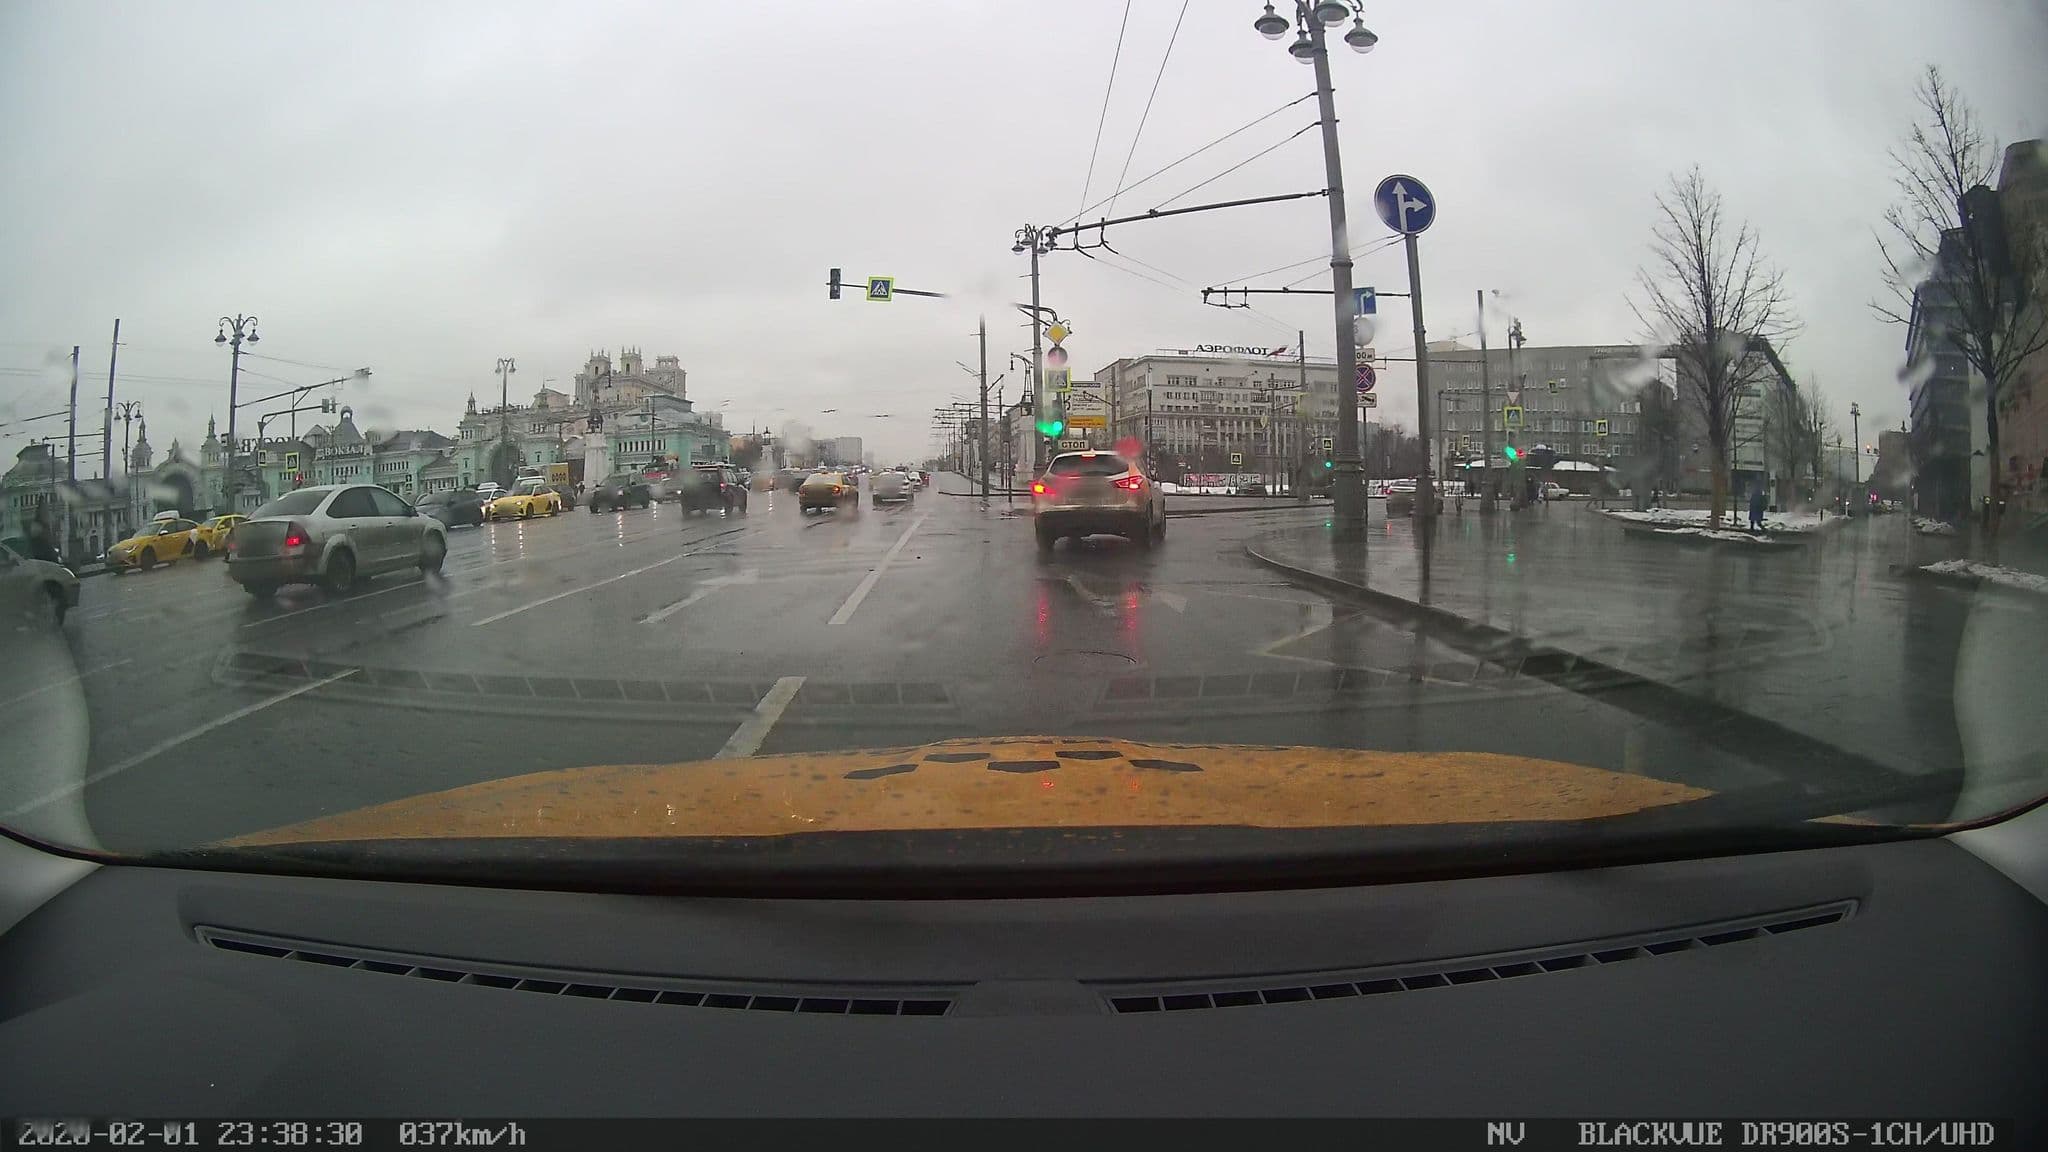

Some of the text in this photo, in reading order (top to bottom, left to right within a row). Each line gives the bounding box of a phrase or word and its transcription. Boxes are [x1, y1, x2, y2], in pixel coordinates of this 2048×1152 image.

[1195, 344, 1269, 356] АЭРОФЛОТ
[325, 445, 364, 456] ВОКЗАЛ
[1061, 441, 1086, 449] СТОП
